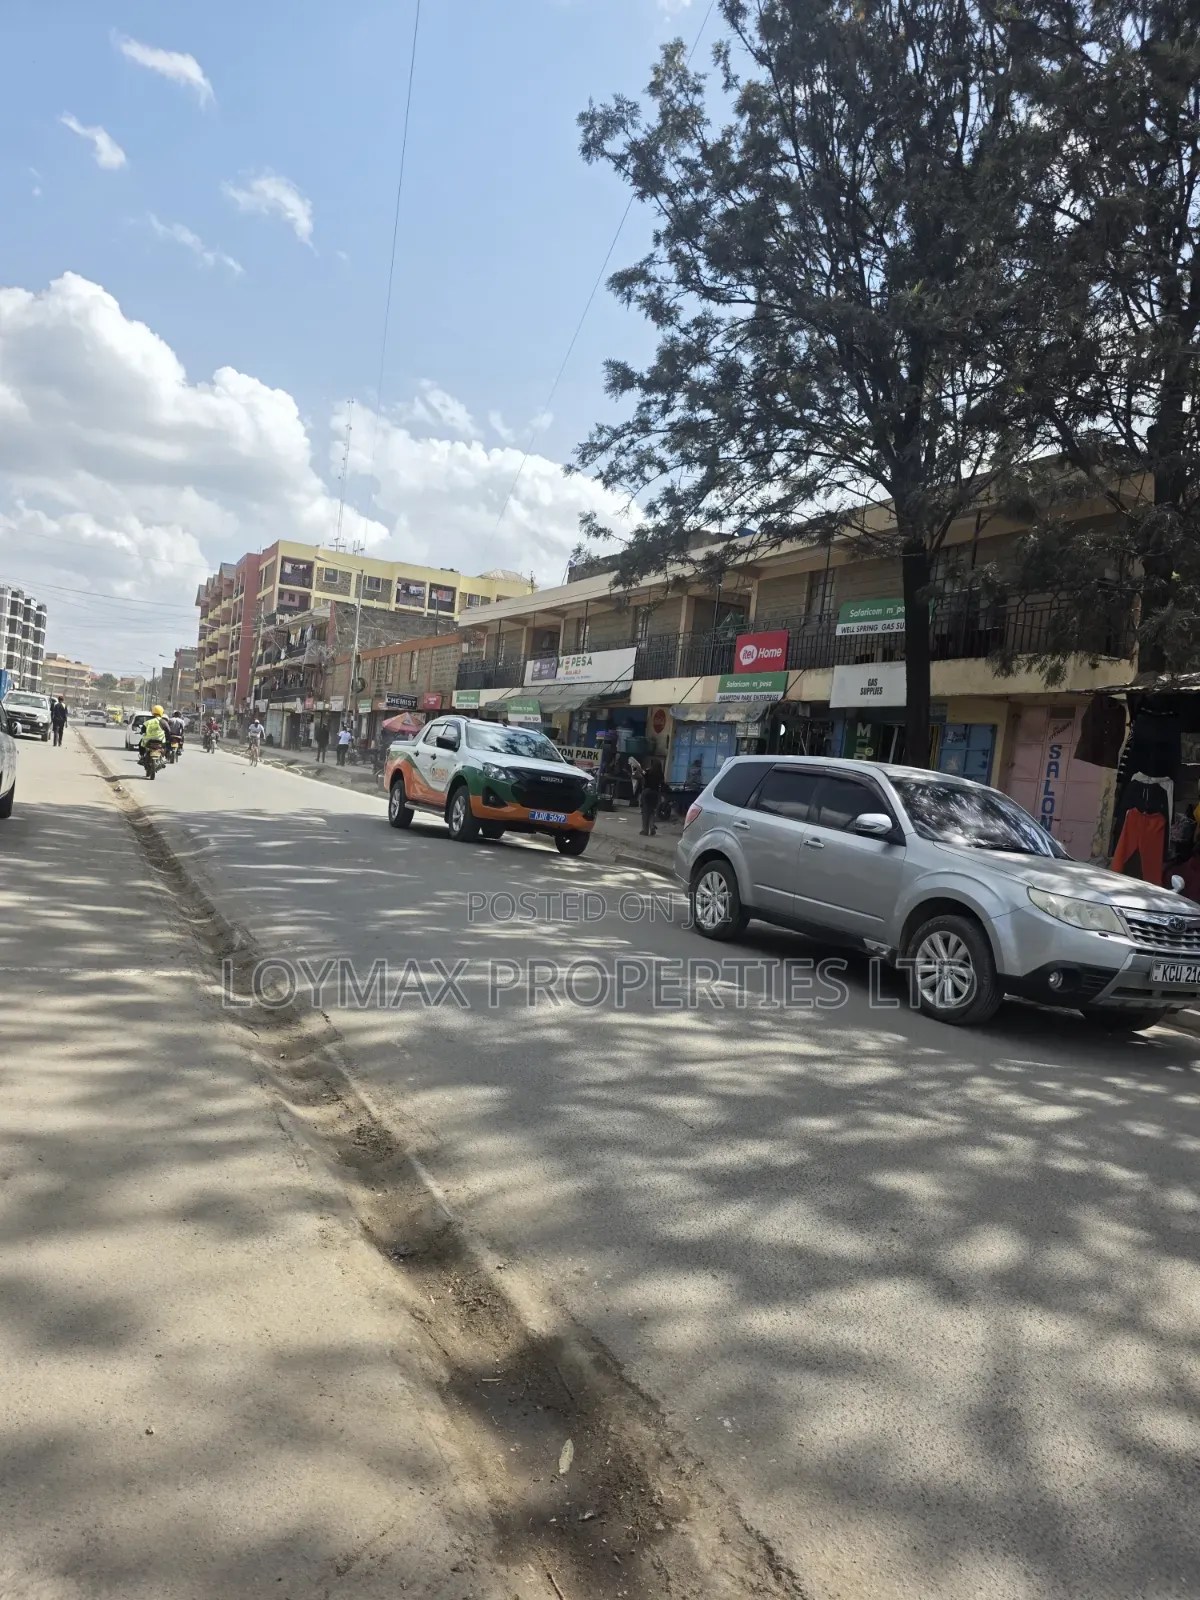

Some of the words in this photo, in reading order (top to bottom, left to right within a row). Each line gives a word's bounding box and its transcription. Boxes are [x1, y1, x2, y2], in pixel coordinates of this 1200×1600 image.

[849, 608, 883, 618] Safaricom
[841, 626, 855, 634] WELL
[856, 624, 879, 632] SPRING
[881, 623, 895, 631] GAS
[742, 649, 755, 660] itel
[757, 647, 783, 659] Home
[726, 680, 750, 688] Safaricom
[867, 678, 878, 687] GAS
[860, 687, 883, 695] SUPPLIES
[386, 696, 417, 707] CHEMIST
[575, 749, 599, 761] PARK
[1040, 744, 1062, 832] SALON
[1162, 964, 1183, 982] KCU
